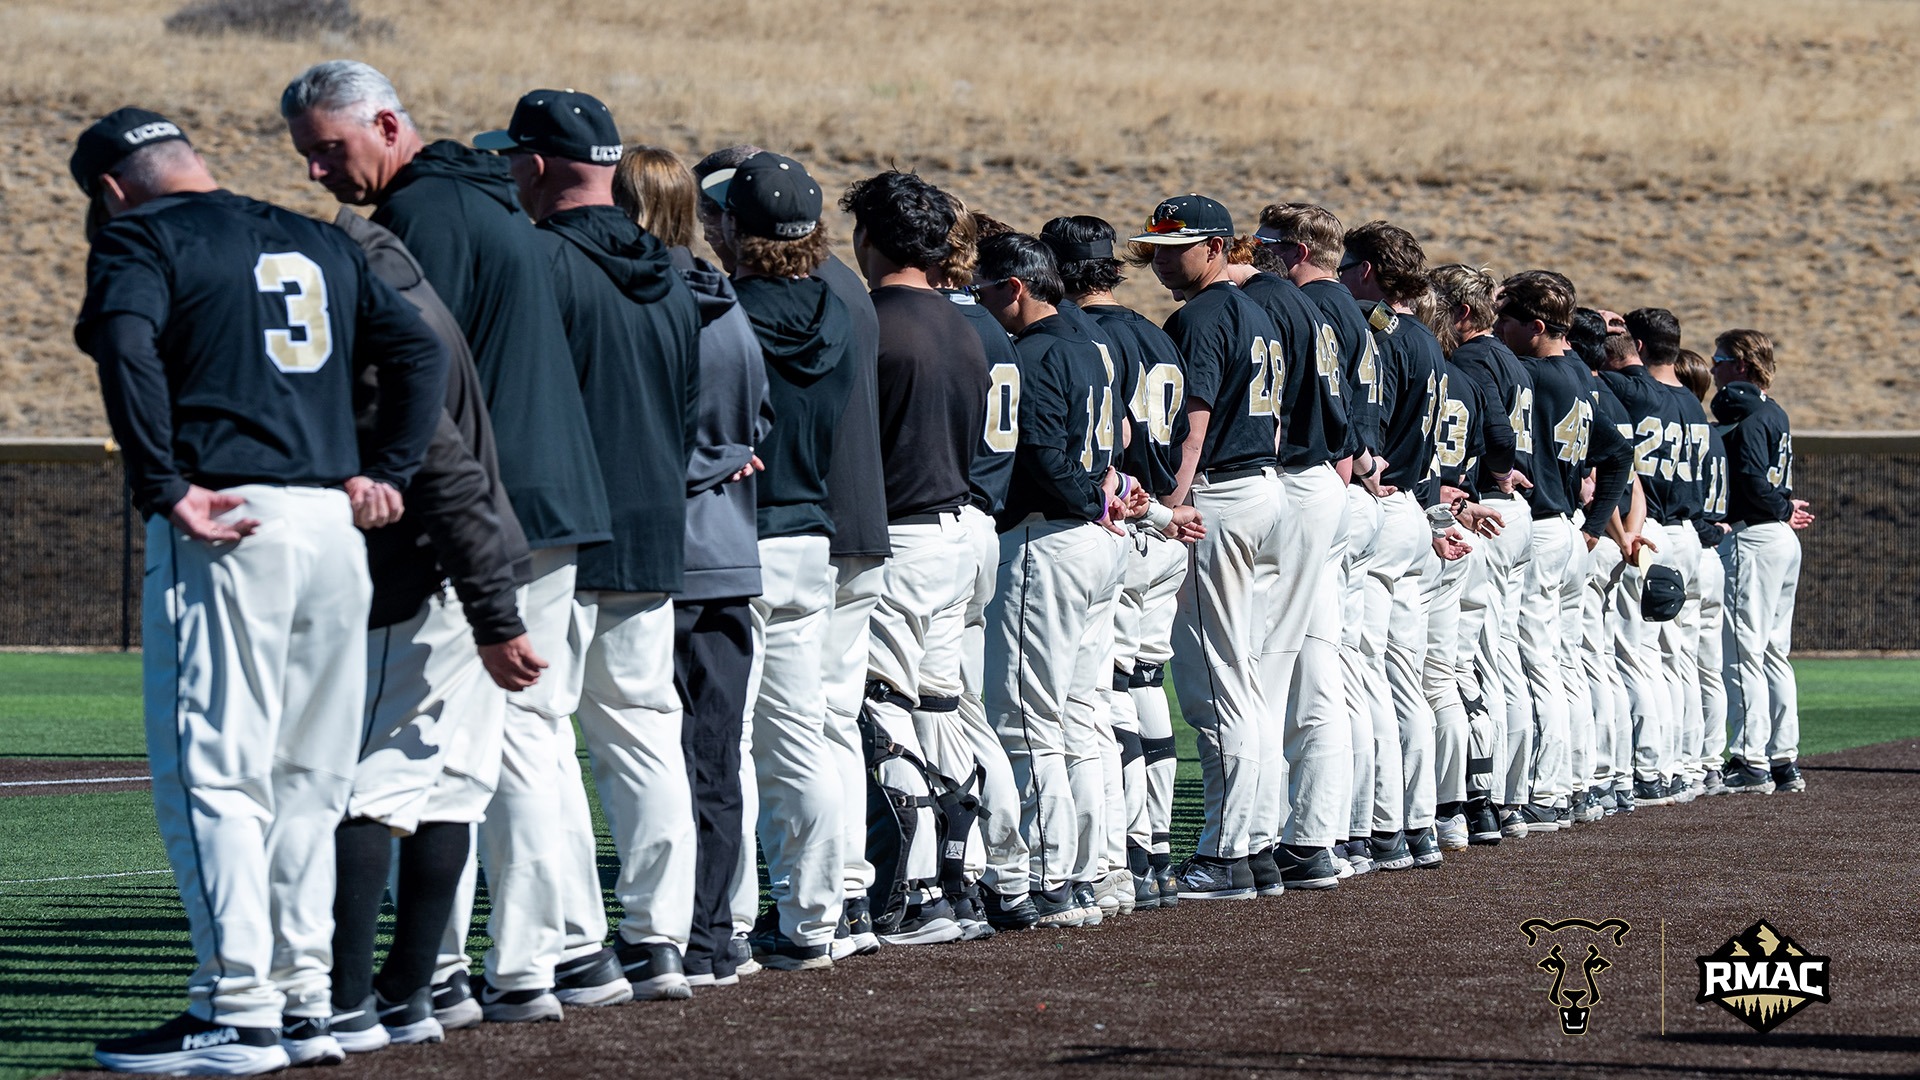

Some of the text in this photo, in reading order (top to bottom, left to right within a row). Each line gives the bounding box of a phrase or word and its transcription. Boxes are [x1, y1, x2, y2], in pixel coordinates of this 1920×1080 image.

[253, 251, 333, 373] 3
[1128, 361, 1184, 445] 40
[1437, 399, 1470, 467] 3
[182, 1027, 240, 1050] HOKA
